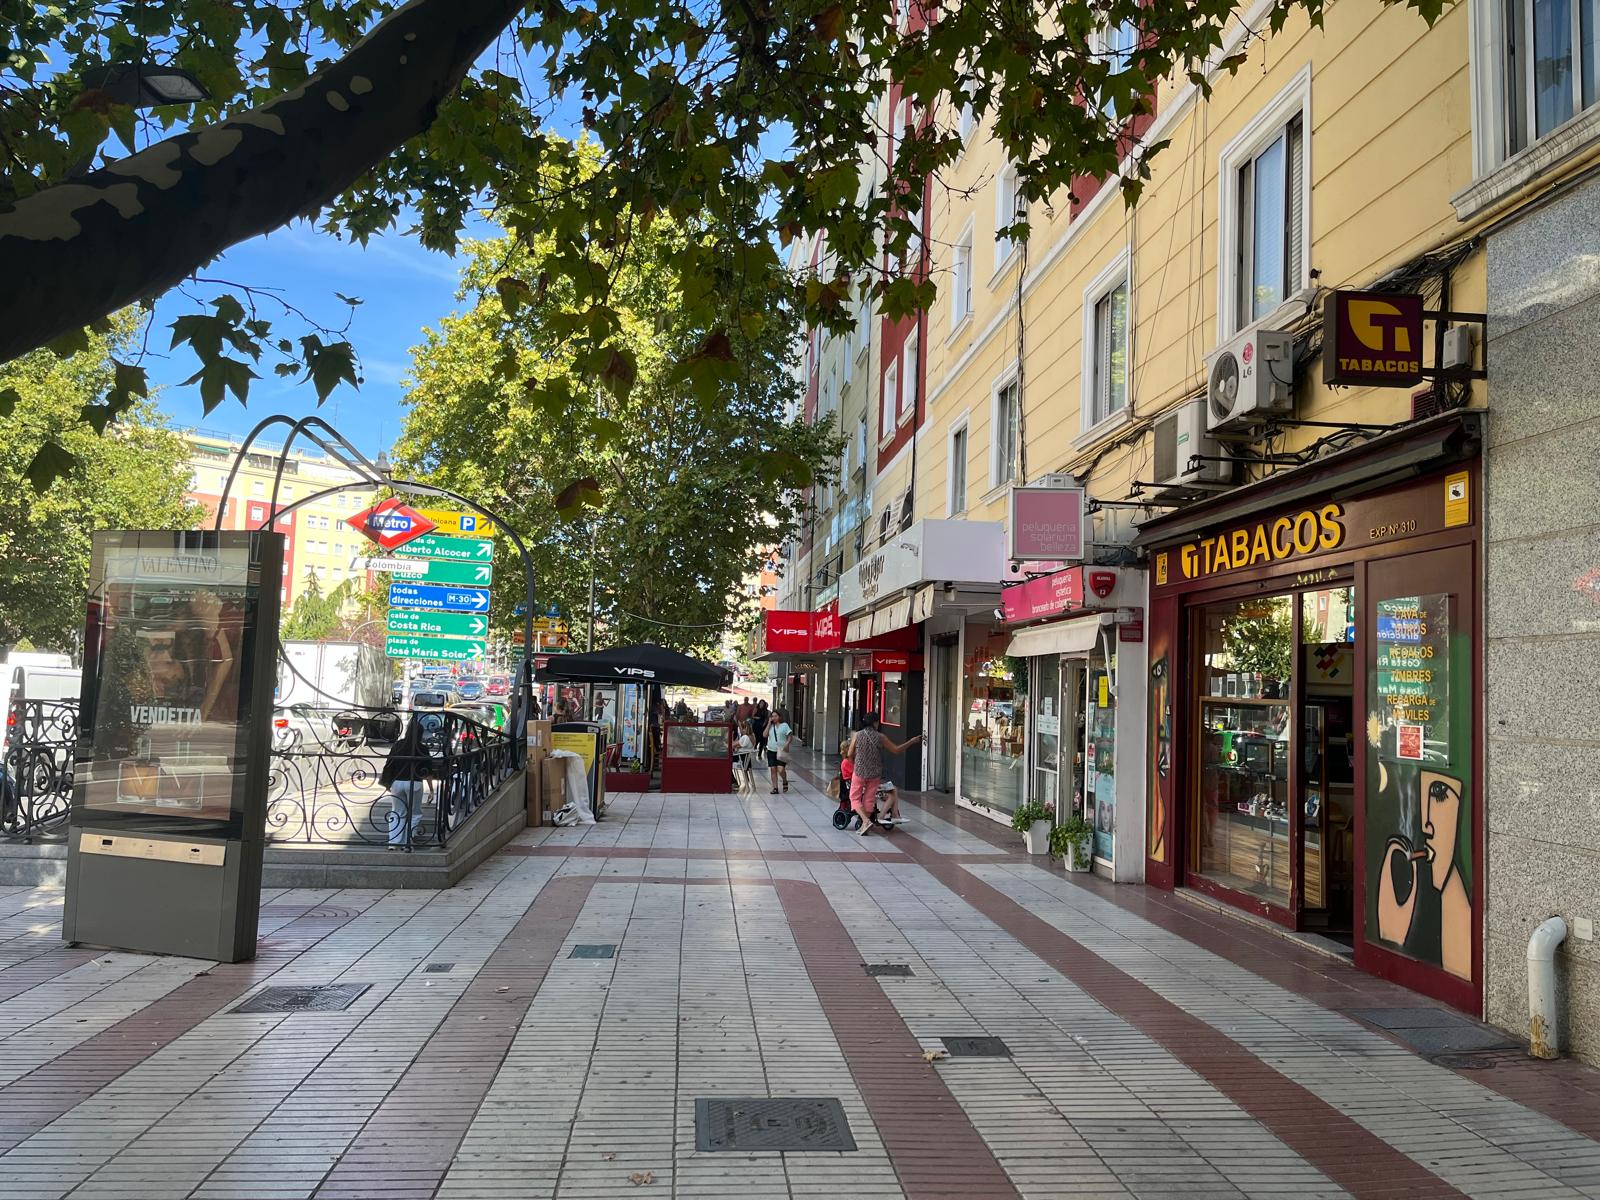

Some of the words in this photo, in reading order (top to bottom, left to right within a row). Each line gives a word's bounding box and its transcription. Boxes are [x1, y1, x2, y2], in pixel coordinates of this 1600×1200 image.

[1339, 358, 1419, 374] TABACOS
[1243, 366, 1252, 379] LG
[372, 516, 409, 529] Metro
[1370, 526, 1387, 539] EXP
[1401, 519, 1416, 533] 310
[426, 537, 436, 545] de
[1201, 503, 1343, 574] TABACOS
[395, 545, 432, 555] Alberto
[433, 548, 471, 558] Alcocer
[1040, 542, 1076, 552] belleza
[142, 556, 218, 574] VALENTINO
[365, 560, 412, 571] Colombia
[393, 570, 423, 579] Cuzco
[392, 586, 418, 595] todas
[391, 596, 443, 607] direcciones
[448, 595, 470, 603] M-30
[390, 612, 409, 620] calle
[1395, 609, 1418, 620] CAVA
[1419, 611, 1428, 619] DE
[389, 621, 418, 631] Costa
[420, 622, 442, 632] Rica
[771, 628, 808, 636] VIPS
[388, 637, 408, 646] plaza
[387, 646, 410, 656] José
[441, 649, 467, 659] Soler
[1388, 646, 1434, 659] REGALOS
[613, 666, 656, 678] VIPS
[1391, 670, 1432, 683] TIMBRES
[1386, 694, 1428, 706] RECARGA
[130, 706, 202, 725] VENDETTA
